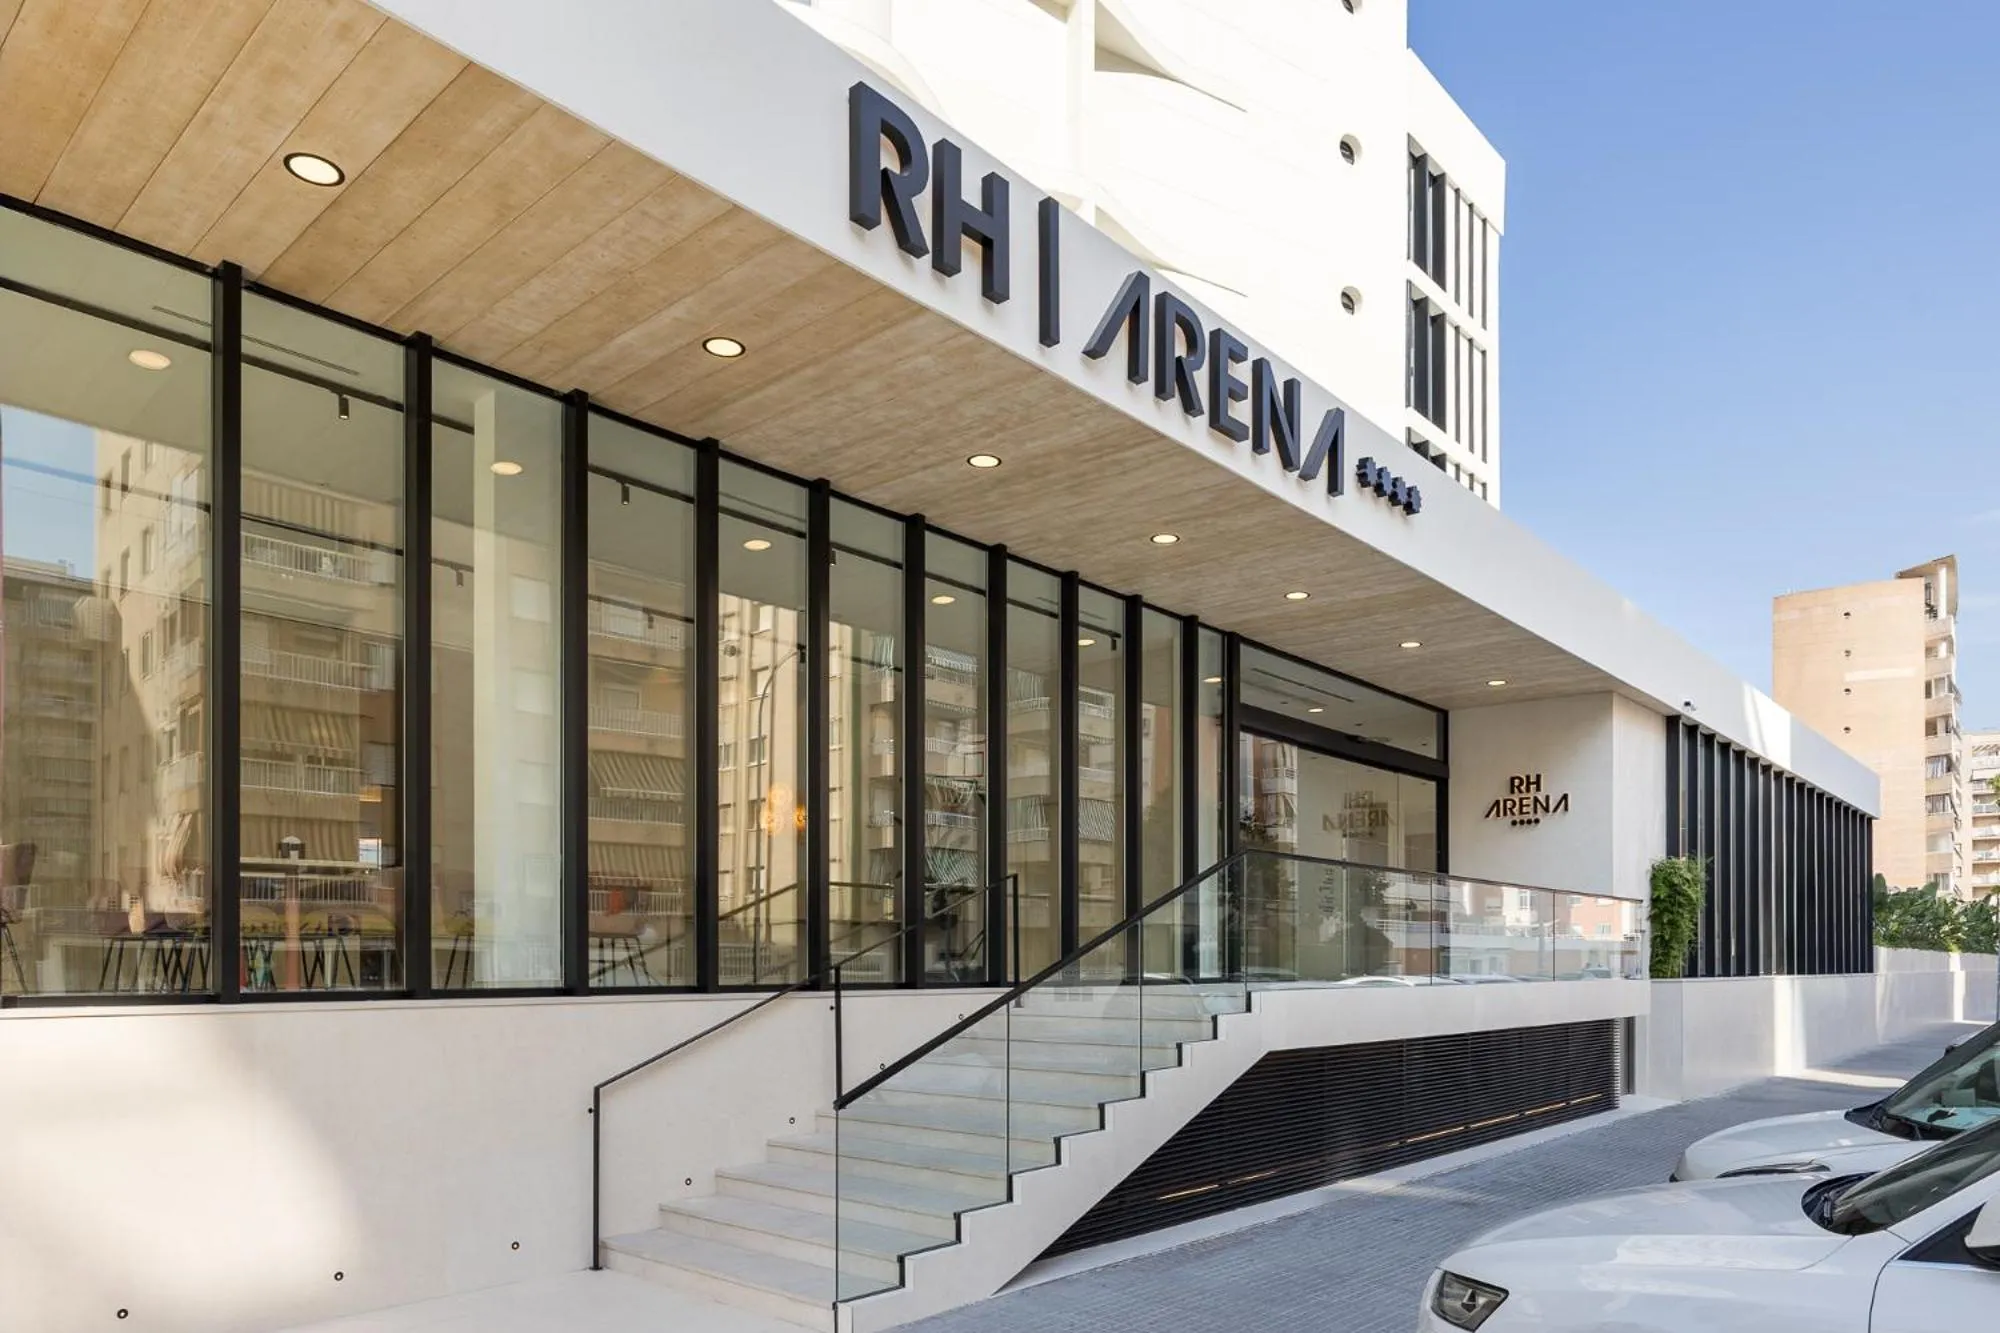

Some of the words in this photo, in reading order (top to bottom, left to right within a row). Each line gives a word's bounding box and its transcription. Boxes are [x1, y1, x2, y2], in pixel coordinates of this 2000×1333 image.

[849, 81, 1010, 304] RH
[1082, 270, 1345, 498] ARENA
[1509, 773, 1541, 794] RH
[1484, 793, 1569, 819] ARENA
